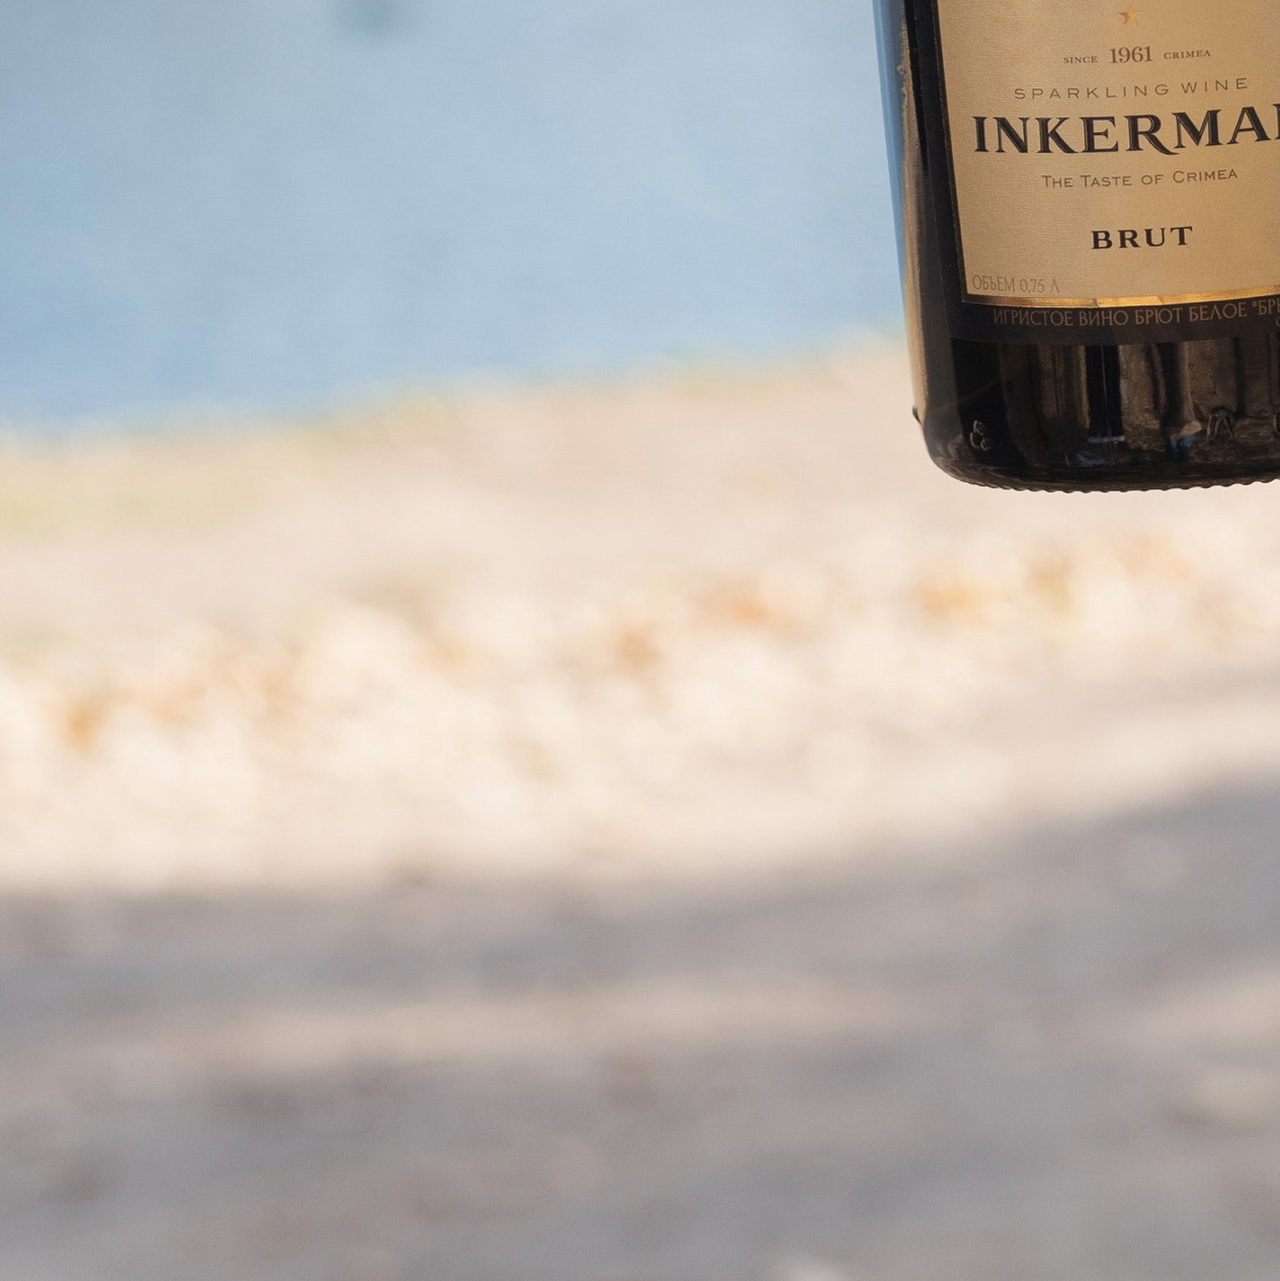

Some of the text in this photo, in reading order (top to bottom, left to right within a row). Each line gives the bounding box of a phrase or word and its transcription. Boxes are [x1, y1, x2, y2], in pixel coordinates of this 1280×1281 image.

[1063, 45, 1211, 64] SINCE 1961 CRIMEA
[1014, 77, 1248, 100] SPARKLING WINE
[1091, 226, 1193, 249] BRUT
[972, 274, 1015, 292] ОБЪЕМ
[1019, 278, 1045, 294] 0,75
[993, 308, 1074, 326] ИГРИСТОЕ
[1079, 309, 1129, 326] ВИНО
[1135, 306, 1183, 325] БРЮТ
[1189, 301, 1248, 322] БЕЛОЕ
